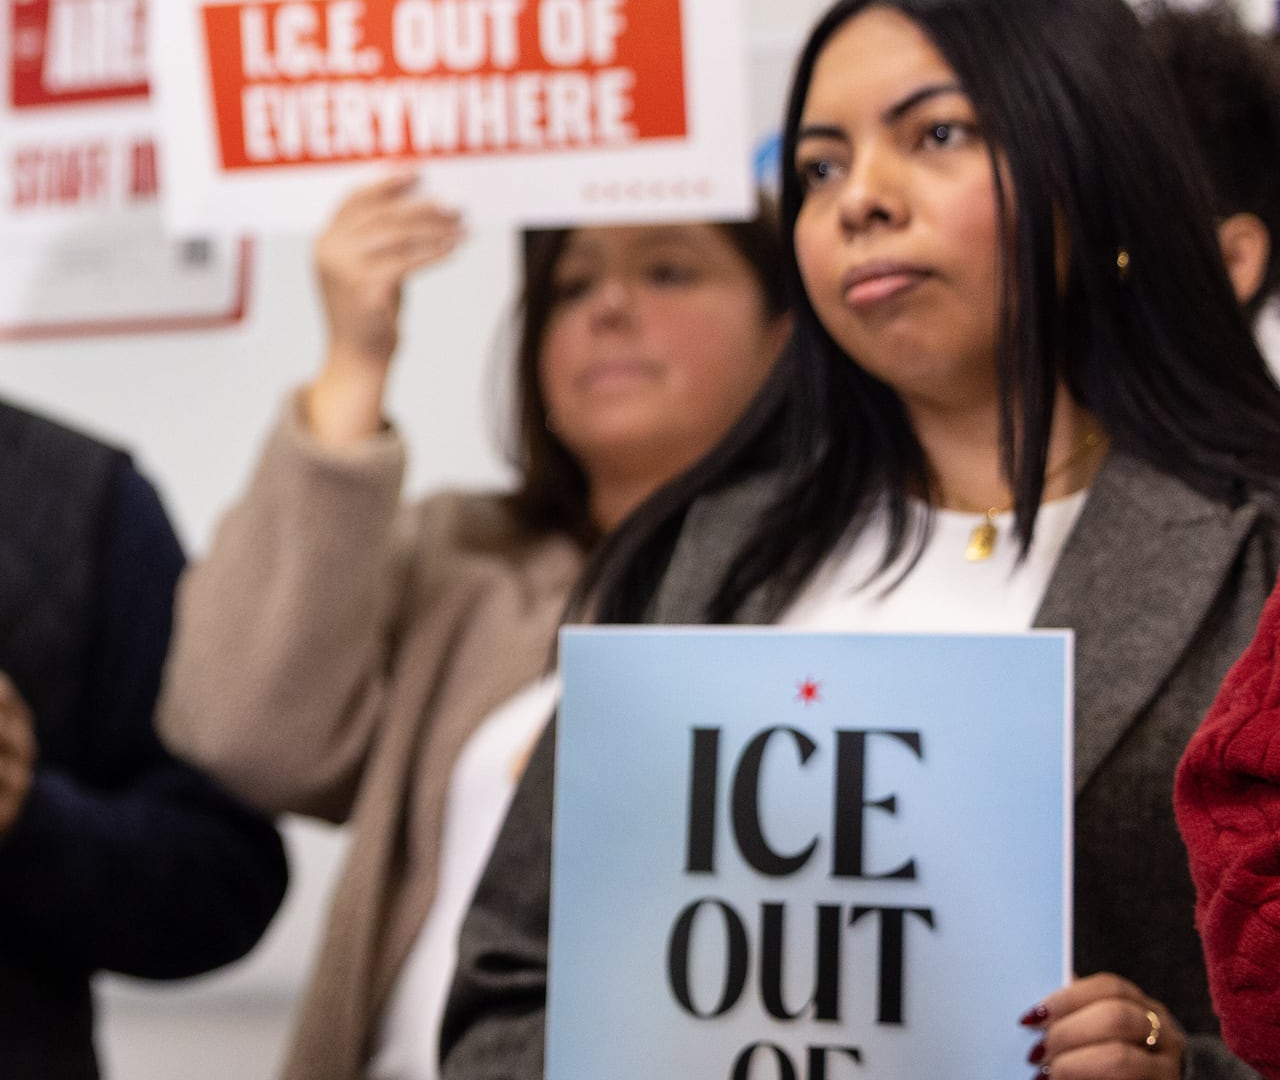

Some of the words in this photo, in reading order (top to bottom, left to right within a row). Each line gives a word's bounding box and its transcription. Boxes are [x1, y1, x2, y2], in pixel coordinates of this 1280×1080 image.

[242, 0, 383, 79] I.C.E.
[242, 67, 638, 162] EVERYWHERE
[684, 724, 925, 881] ICE
[665, 896, 938, 1027] OUT
